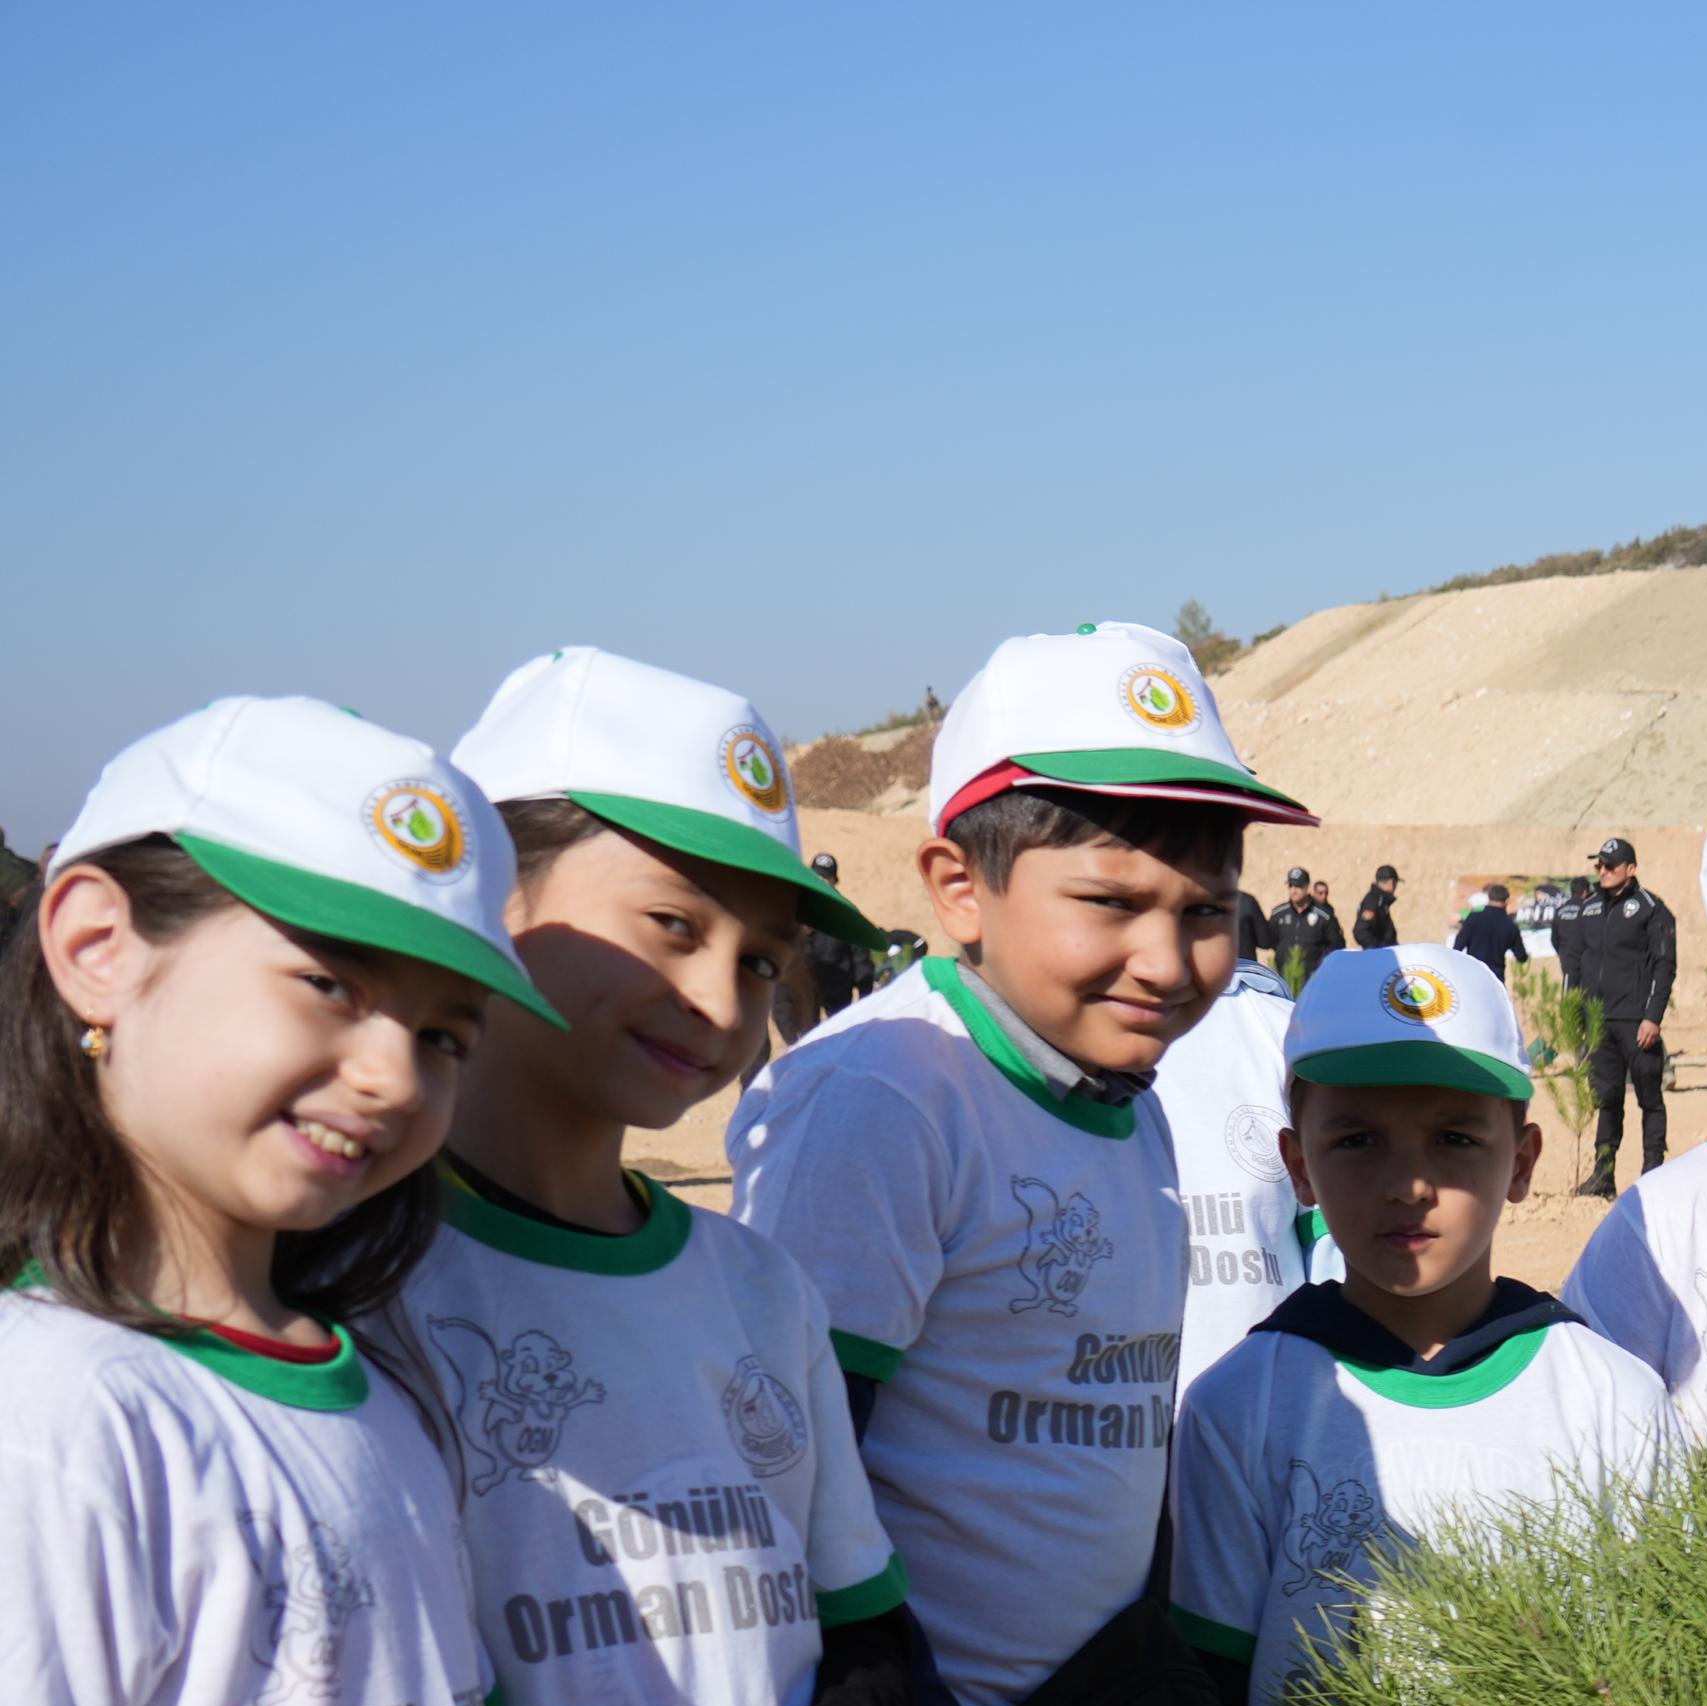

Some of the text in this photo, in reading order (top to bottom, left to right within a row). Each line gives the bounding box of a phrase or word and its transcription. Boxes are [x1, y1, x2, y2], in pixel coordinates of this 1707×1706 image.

[517, 1426, 554, 1456] OGM
[988, 1390, 1145, 1449] Orman
[575, 1486, 776, 1567] Gönüllü
[503, 1580, 714, 1664] Orman
